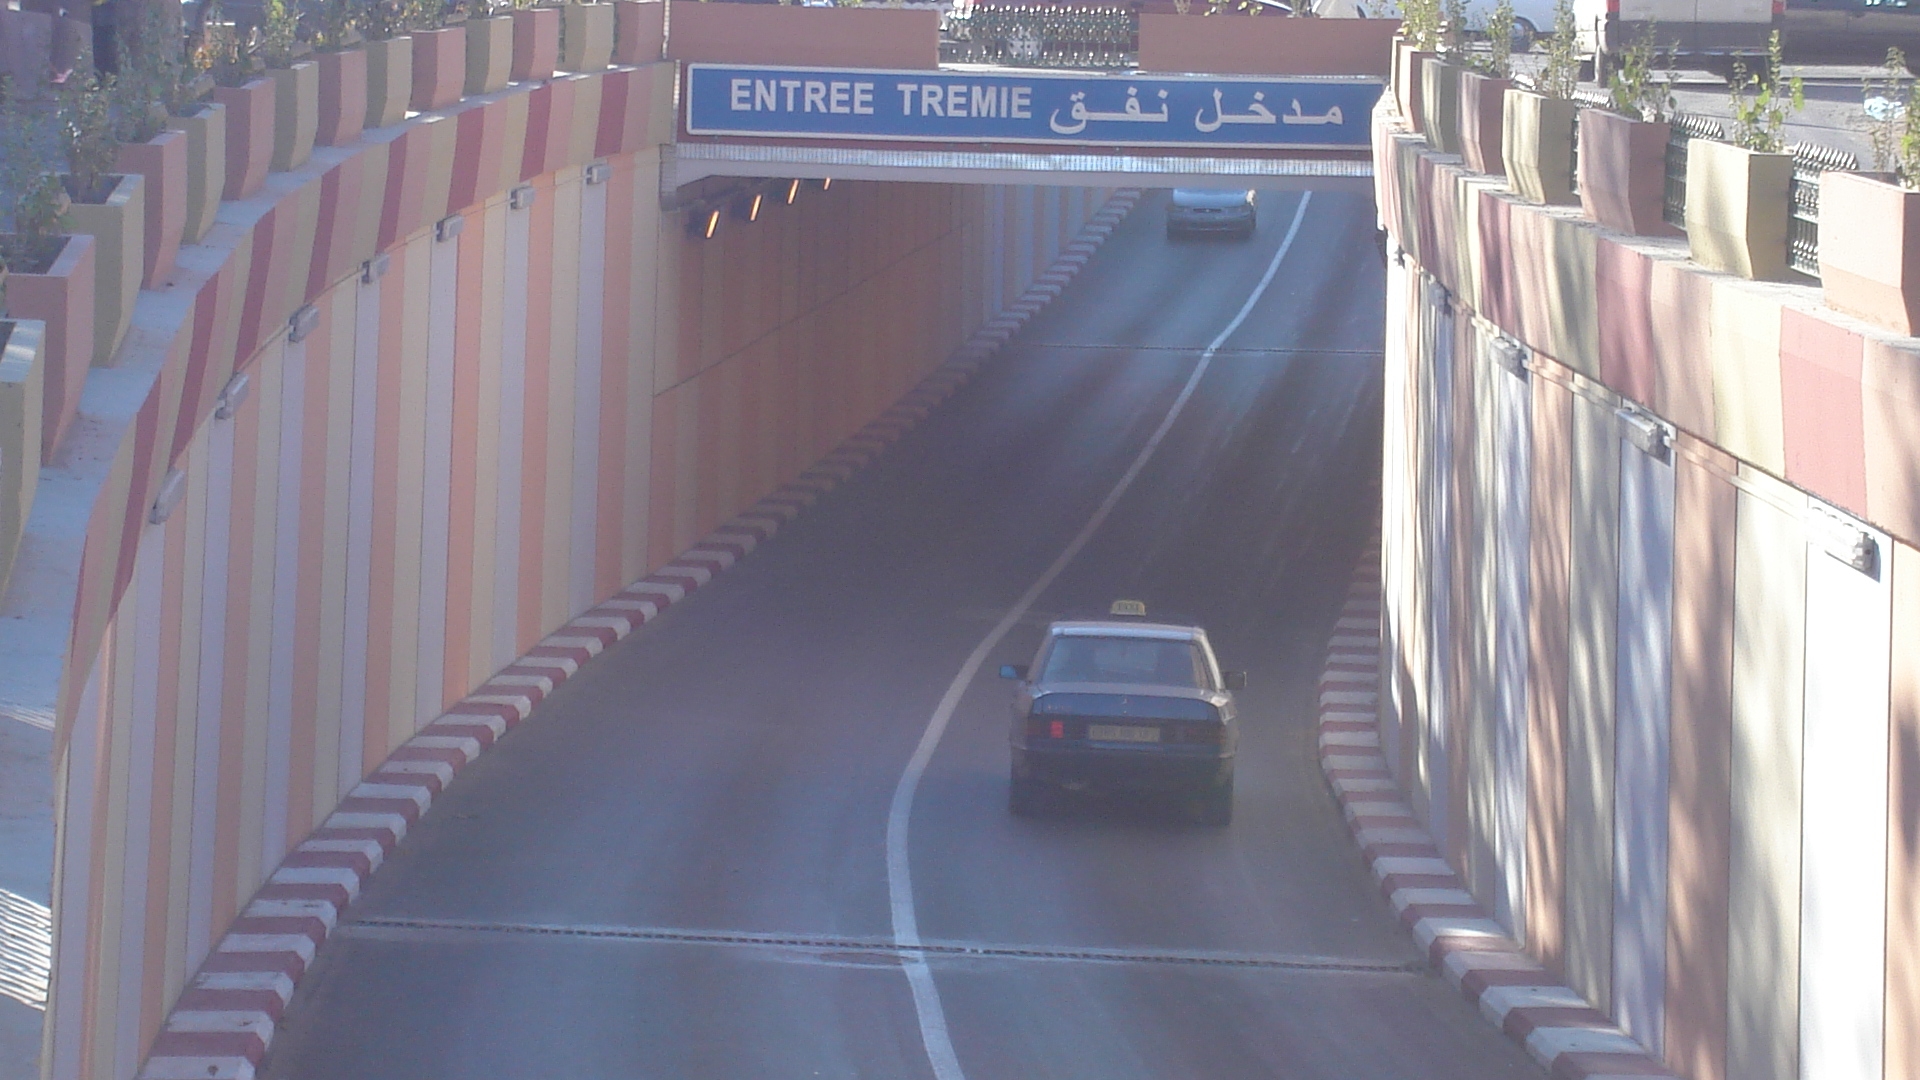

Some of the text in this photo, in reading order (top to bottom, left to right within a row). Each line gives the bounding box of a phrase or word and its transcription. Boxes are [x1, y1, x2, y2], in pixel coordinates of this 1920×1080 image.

[730, 79, 1032, 118] ENTREE TREMIE
[1049, 87, 1345, 134] مدخل نفق
